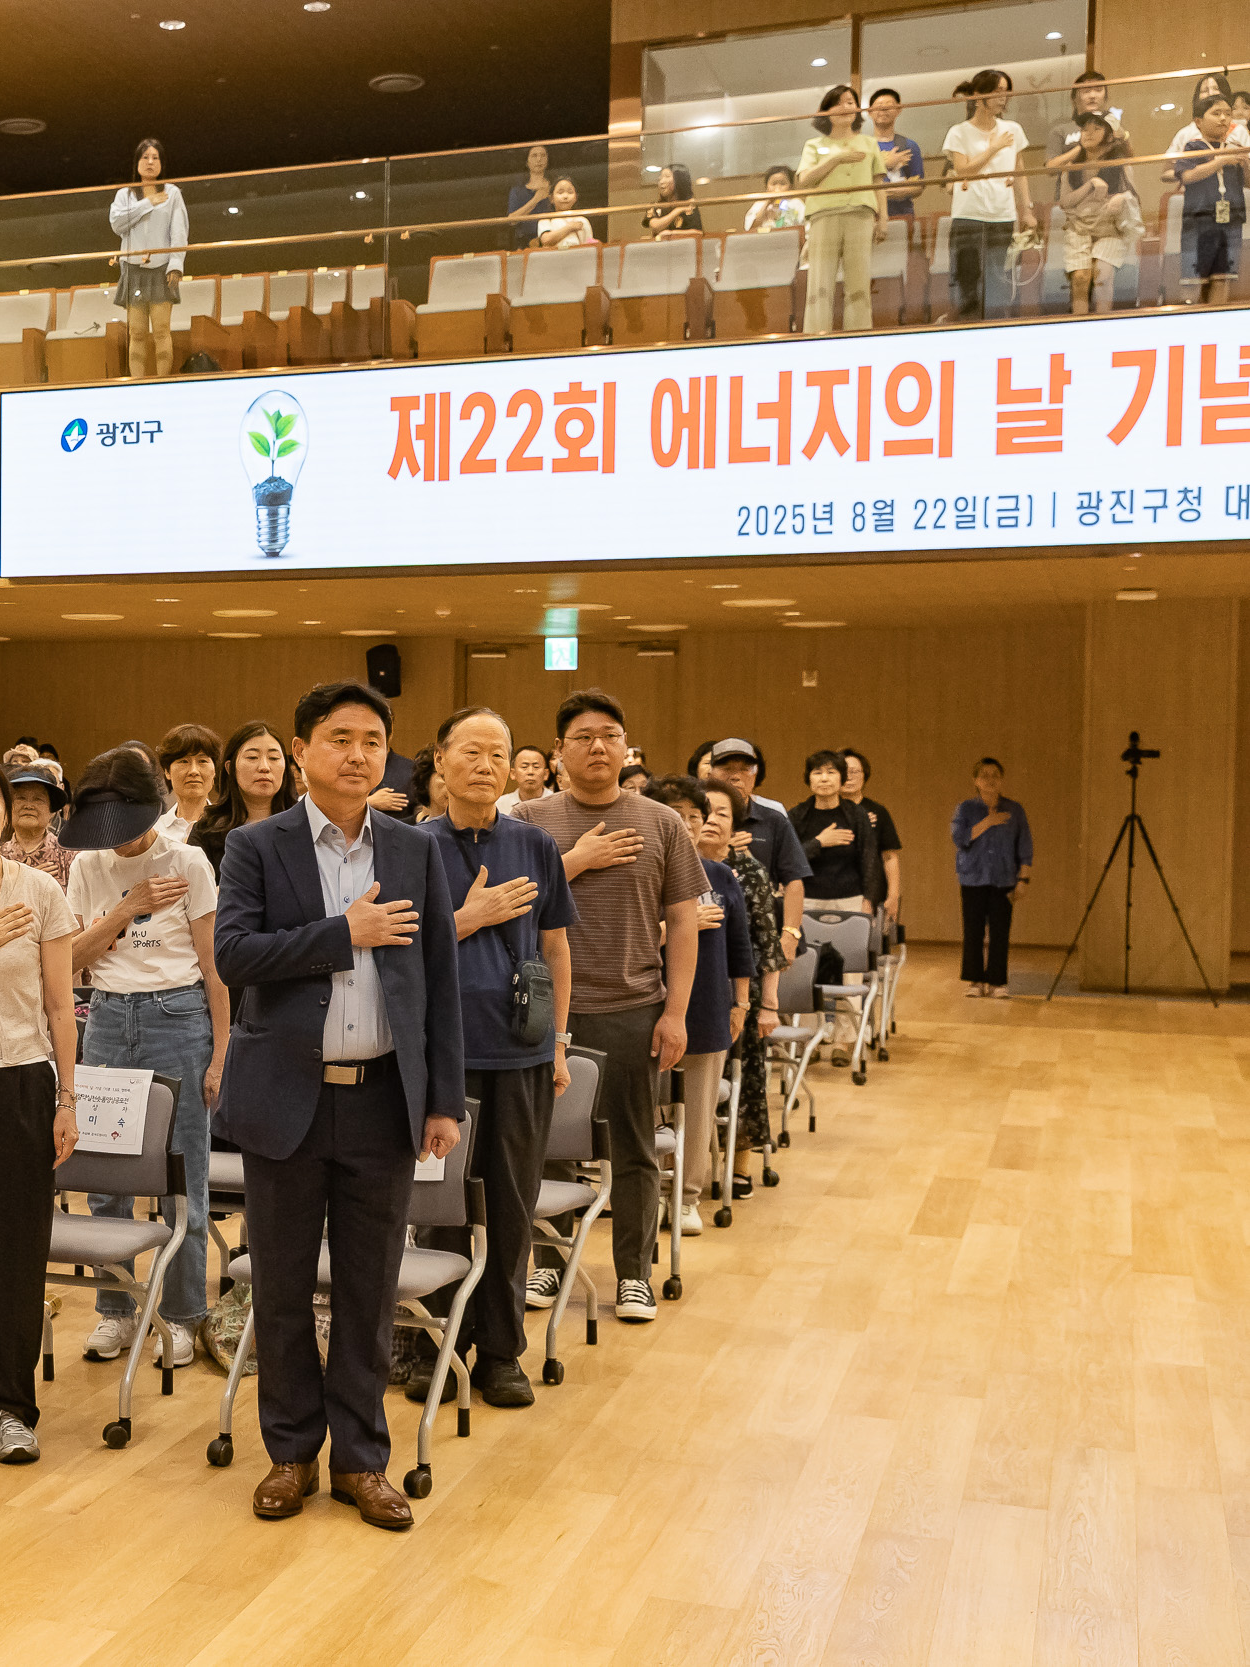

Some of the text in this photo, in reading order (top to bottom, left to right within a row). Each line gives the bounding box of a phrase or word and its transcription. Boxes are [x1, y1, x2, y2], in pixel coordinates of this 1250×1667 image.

[95, 420, 164, 448] 광진구
[387, 343, 1250, 482] 제22회 에너지의 날 기념
[737, 501, 834, 537] 2025년
[852, 499, 895, 533] 8월
[913, 493, 1033, 530] 22일(금)
[1076, 486, 1202, 527] 광진구청
